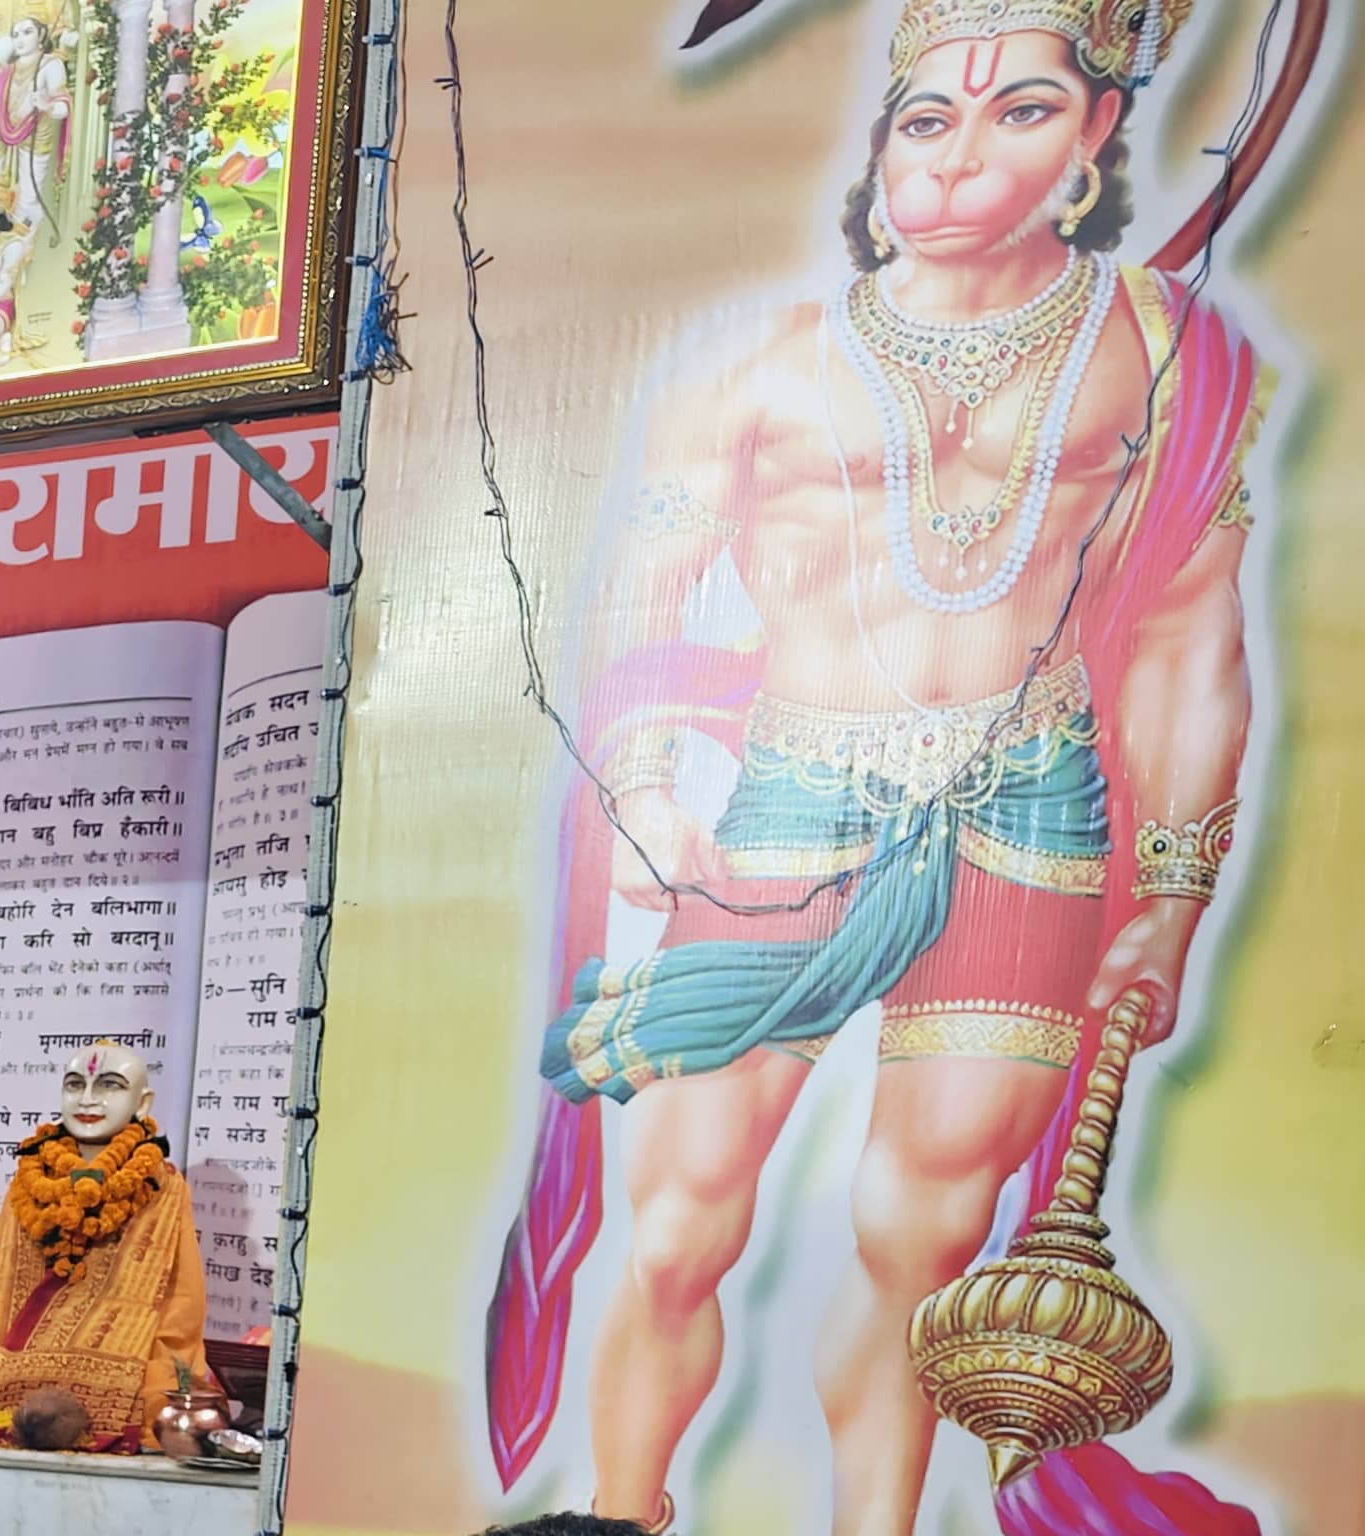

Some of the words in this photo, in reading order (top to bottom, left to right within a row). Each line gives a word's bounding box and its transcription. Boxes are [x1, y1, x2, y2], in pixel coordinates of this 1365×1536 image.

[268, 689, 310, 710] सदन
[255, 724, 301, 748] उचित
[101, 785, 135, 807] अति
[32, 825, 56, 846] बहु
[256, 833, 291, 856] तजि
[258, 866, 289, 889] होइ
[51, 898, 75, 919] देन
[23, 928, 56, 950] करि
[72, 926, 93, 947] सो
[247, 1011, 278, 1028] राम
[232, 1096, 262, 1111] राम
[20, 1111, 43, 1126] नर
